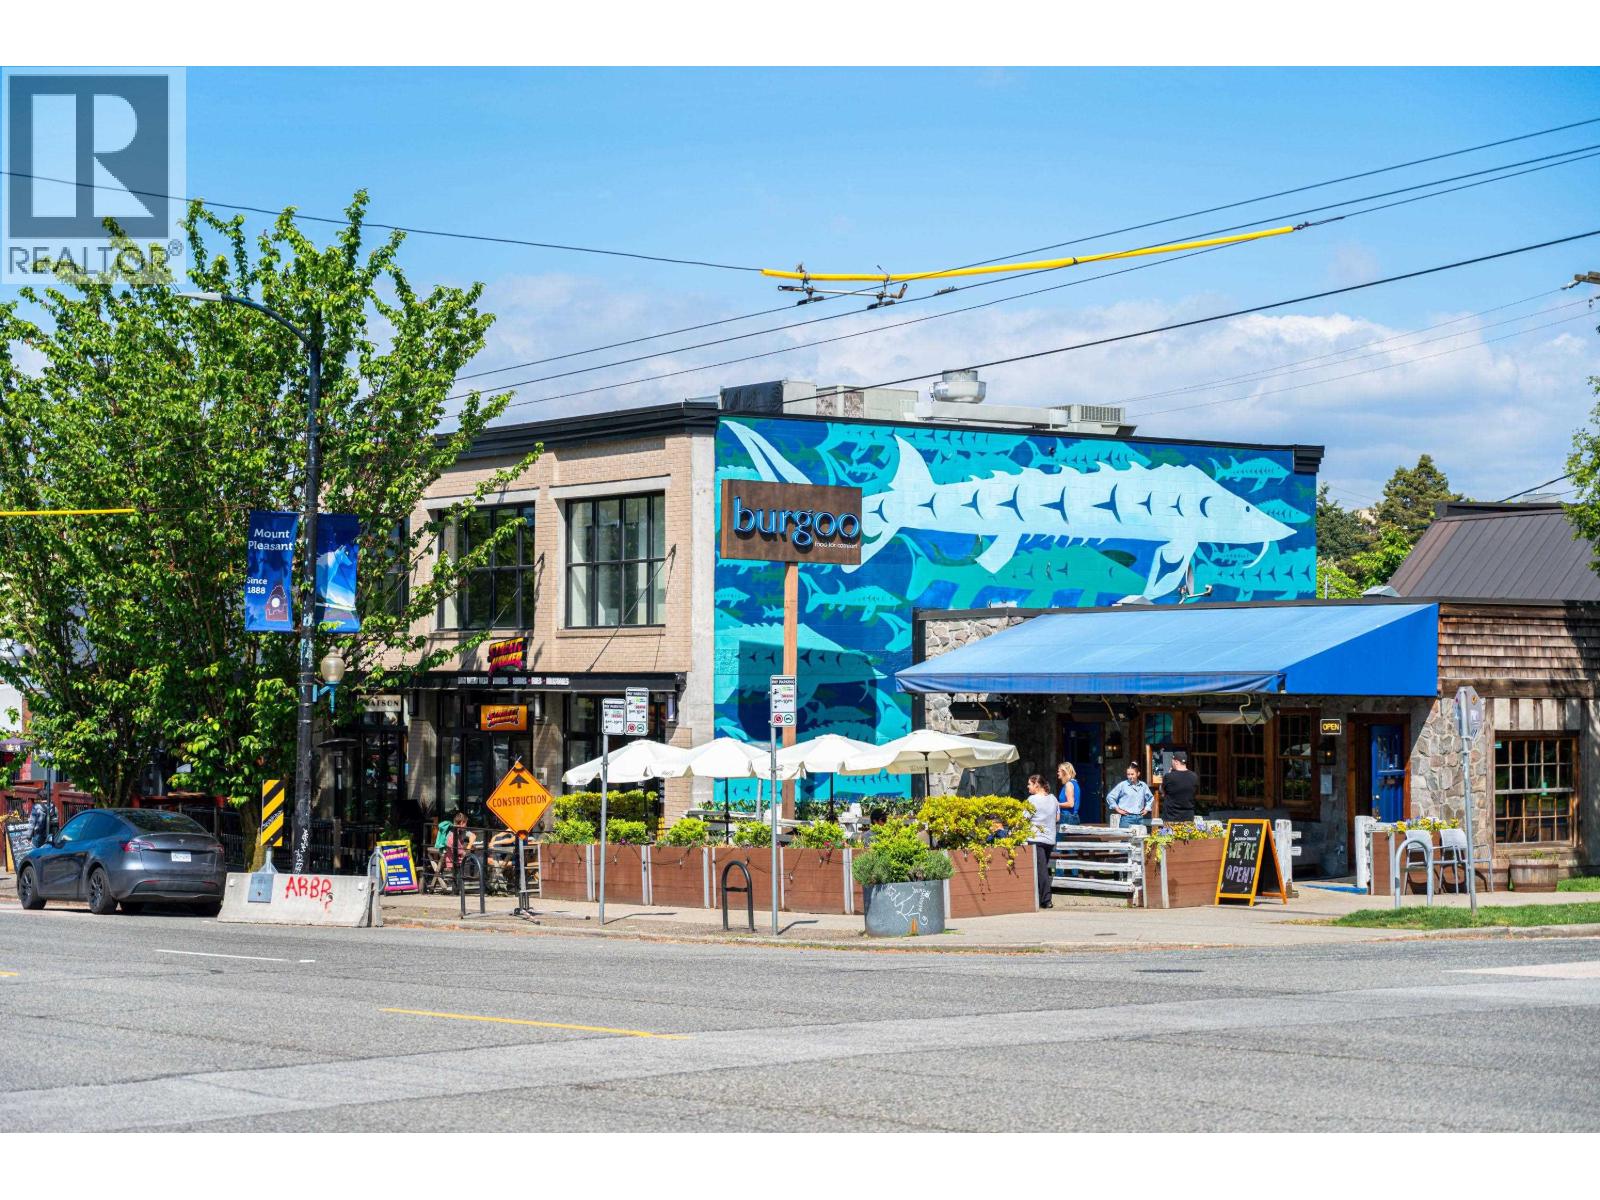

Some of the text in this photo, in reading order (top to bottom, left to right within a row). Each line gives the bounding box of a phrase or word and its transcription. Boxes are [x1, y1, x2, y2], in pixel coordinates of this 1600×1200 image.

[733, 496, 860, 547] burgoo
[254, 528, 290, 539] Mount
[248, 540, 293, 551] Pleasant
[246, 577, 268, 585] Since
[247, 586, 266, 595] 1888
[1322, 723, 1340, 731] OPEN
[492, 795, 547, 808] CONSTRUCTION
[1228, 841, 1257, 860] WE'RE
[1225, 864, 1256, 884] OPEN!
